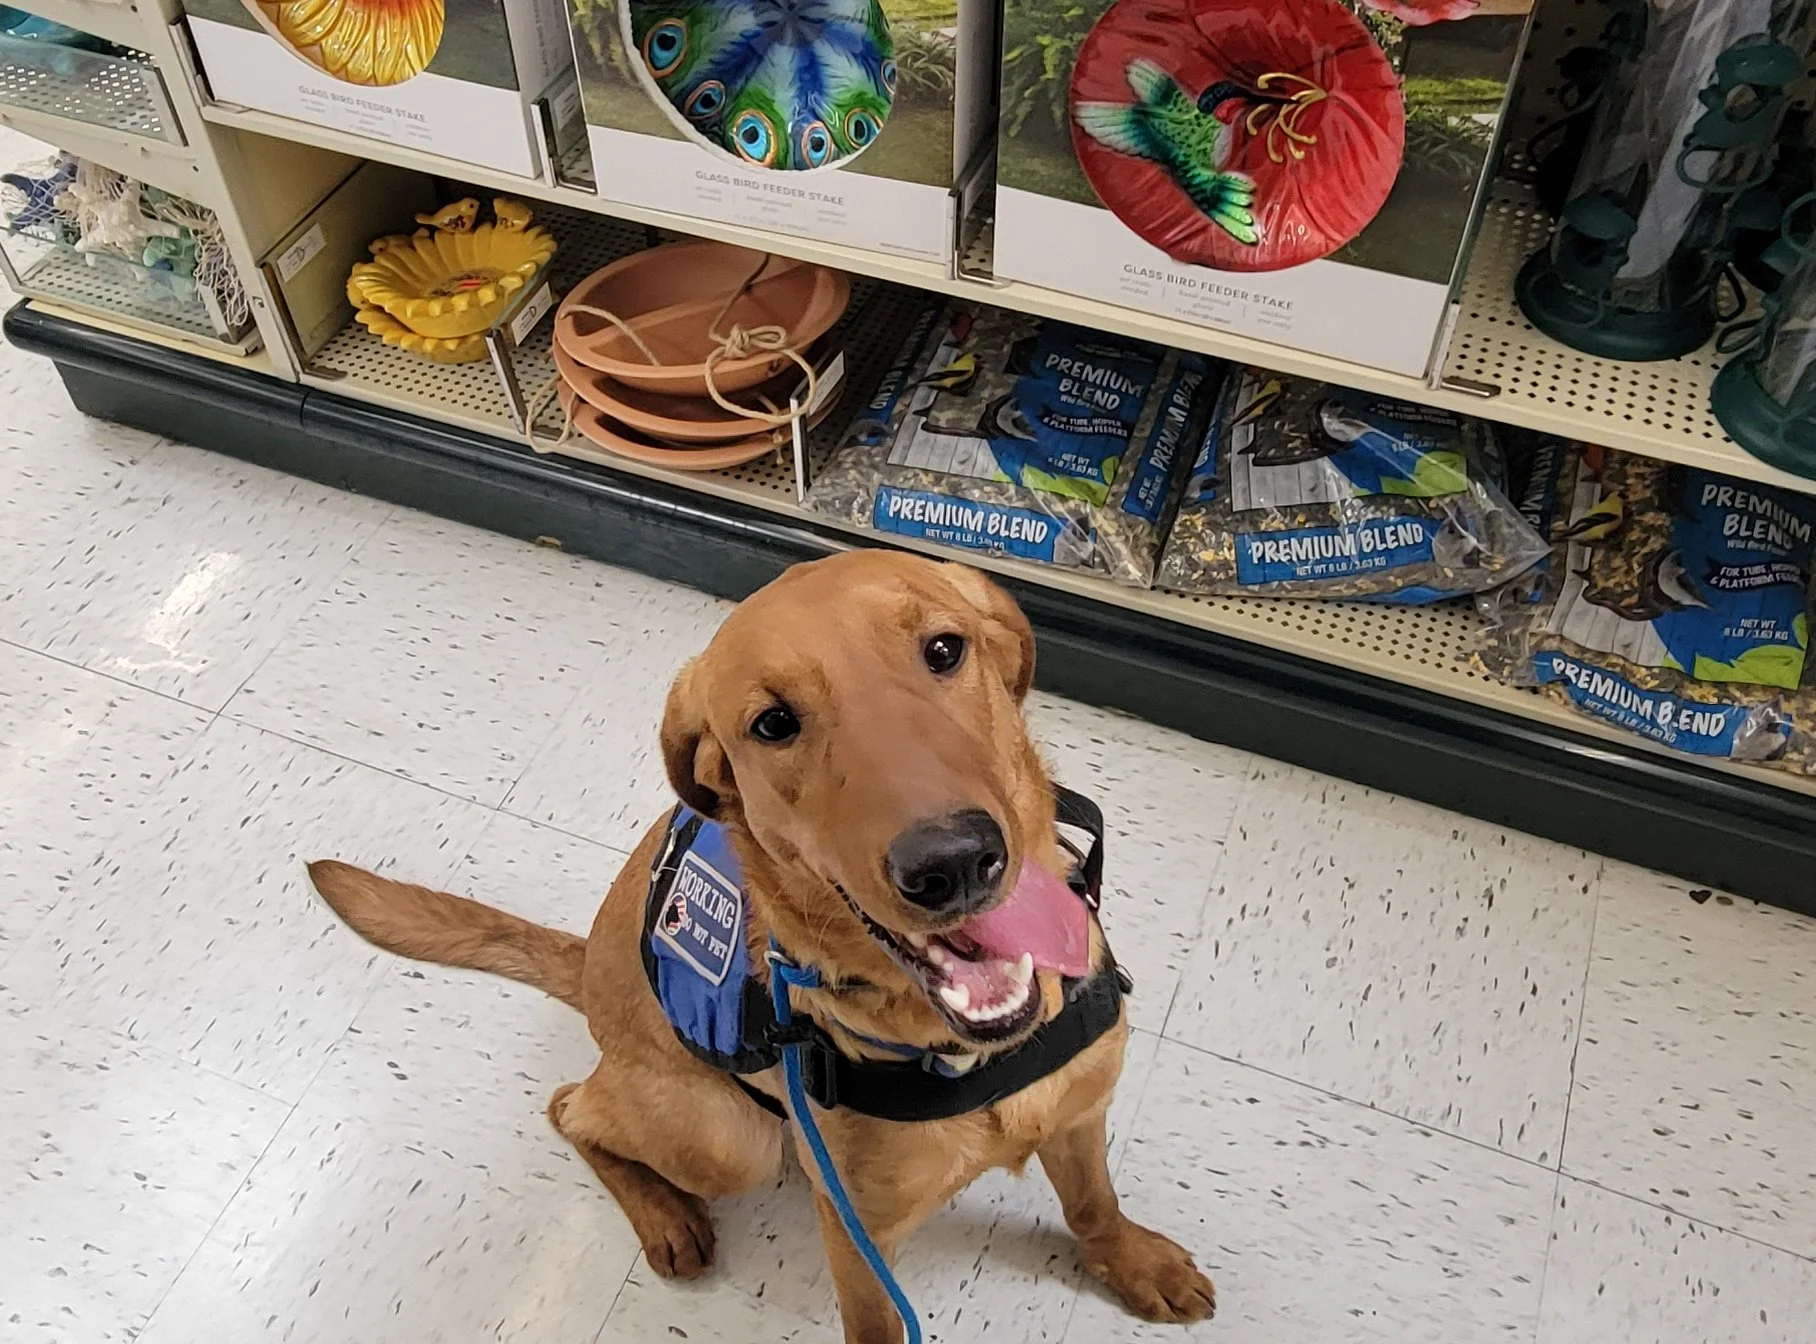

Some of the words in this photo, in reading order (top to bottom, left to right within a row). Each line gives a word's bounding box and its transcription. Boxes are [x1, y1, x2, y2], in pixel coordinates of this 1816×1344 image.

[298, 85, 329, 99] GLASS
[331, 93, 354, 105] BIRD
[356, 99, 392, 114] FEEDER
[395, 108, 427, 123] STAKE
[695, 170, 730, 184] GLASS
[733, 177, 760, 190] BIRD
[763, 183, 807, 198] FEEDER
[808, 192, 845, 206] STAKE
[1124, 263, 1163, 280] GLASS
[1167, 273, 1197, 288] BIRD
[1200, 281, 1250, 301] FEEDER
[1253, 294, 1295, 311] STAKE
[1045, 353, 1144, 398] PREMIUM
[1059, 377, 1120, 410] BLEND
[1095, 425, 1128, 437] FEEDERS
[888, 495, 984, 533] PREMIUM
[987, 512, 1048, 544] BLEND
[1701, 484, 1811, 543] PREMIUM
[1723, 513, 1793, 550] BLEND
[926, 528, 940, 537] NET
[942, 531, 954, 539] WT
[955, 532, 961, 541] 8
[962, 534, 972, 543] LB
[1250, 533, 1357, 564] PREMIUM
[1360, 523, 1423, 553] BLEND
[1296, 566, 1312, 576] NET
[1314, 564, 1327, 574] WT
[1336, 562, 1348, 572] LB
[1355, 558, 1373, 570] 3.63
[1374, 556, 1387, 567] KG
[1709, 575, 1718, 585] &
[1718, 573, 1774, 588] PLATFORM
[1720, 566, 1740, 577] FOR
[1732, 628, 1744, 637] LB
[1753, 630, 1772, 640] 3.63
[1774, 631, 1789, 641] KG
[1740, 619, 1759, 629] NET
[1760, 620, 1776, 629] WT
[1552, 657, 1653, 721] PREMIUM
[1584, 698, 1601, 713] NET
[1603, 706, 1617, 717] WT
[1663, 731, 1678, 744] KG
[679, 866, 735, 929] WORKING
[692, 922, 709, 945] NOT
[708, 936, 728, 960] PET
